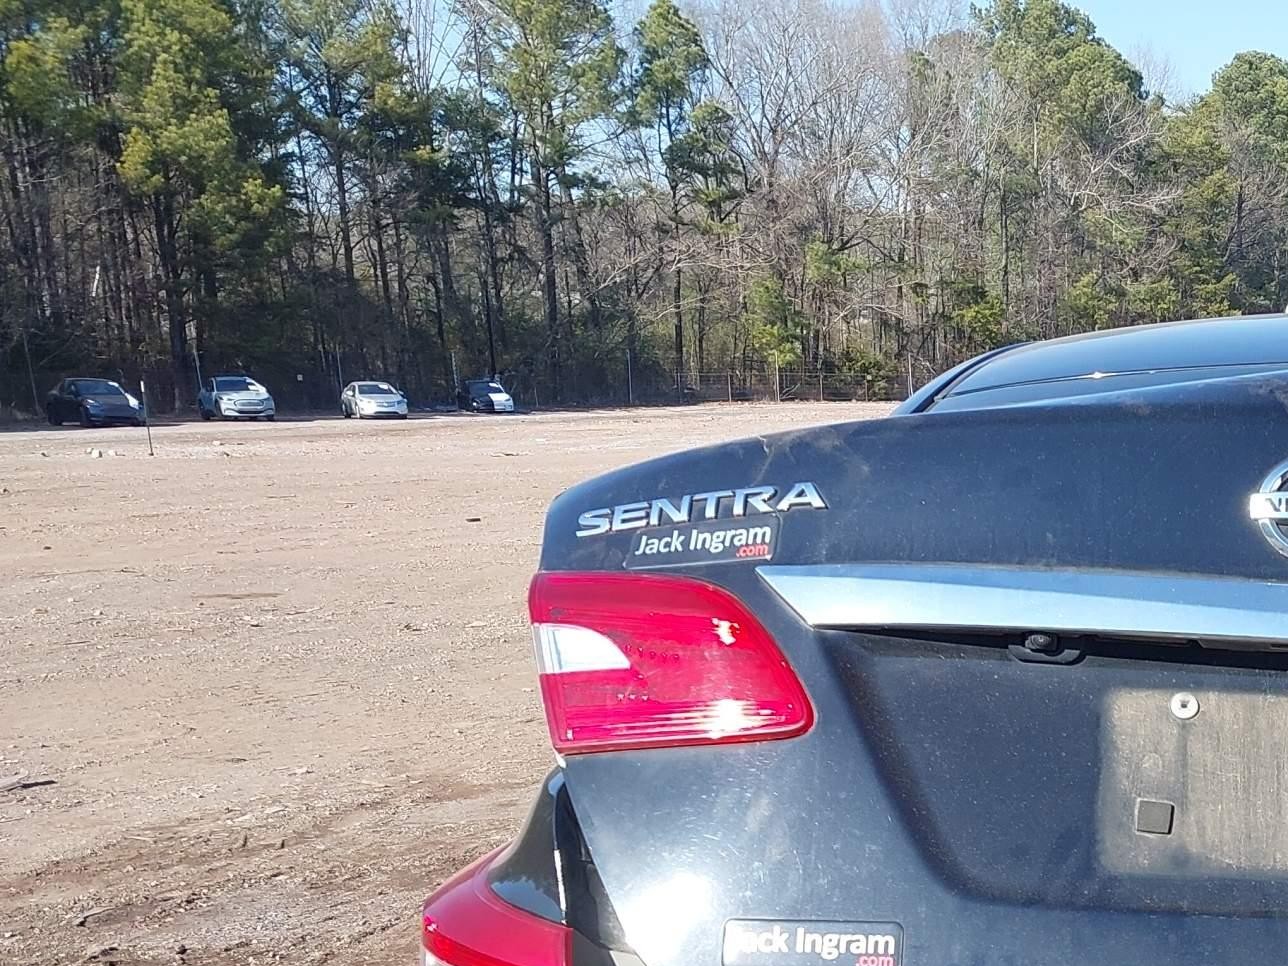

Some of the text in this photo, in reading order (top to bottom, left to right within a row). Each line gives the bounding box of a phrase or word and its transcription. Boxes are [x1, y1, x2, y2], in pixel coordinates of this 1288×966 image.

[576, 482, 829, 537] SENTRA
[634, 525, 771, 556] Jack Ingram
[736, 543, 769, 558] .com
[795, 927, 896, 960] Ingram
